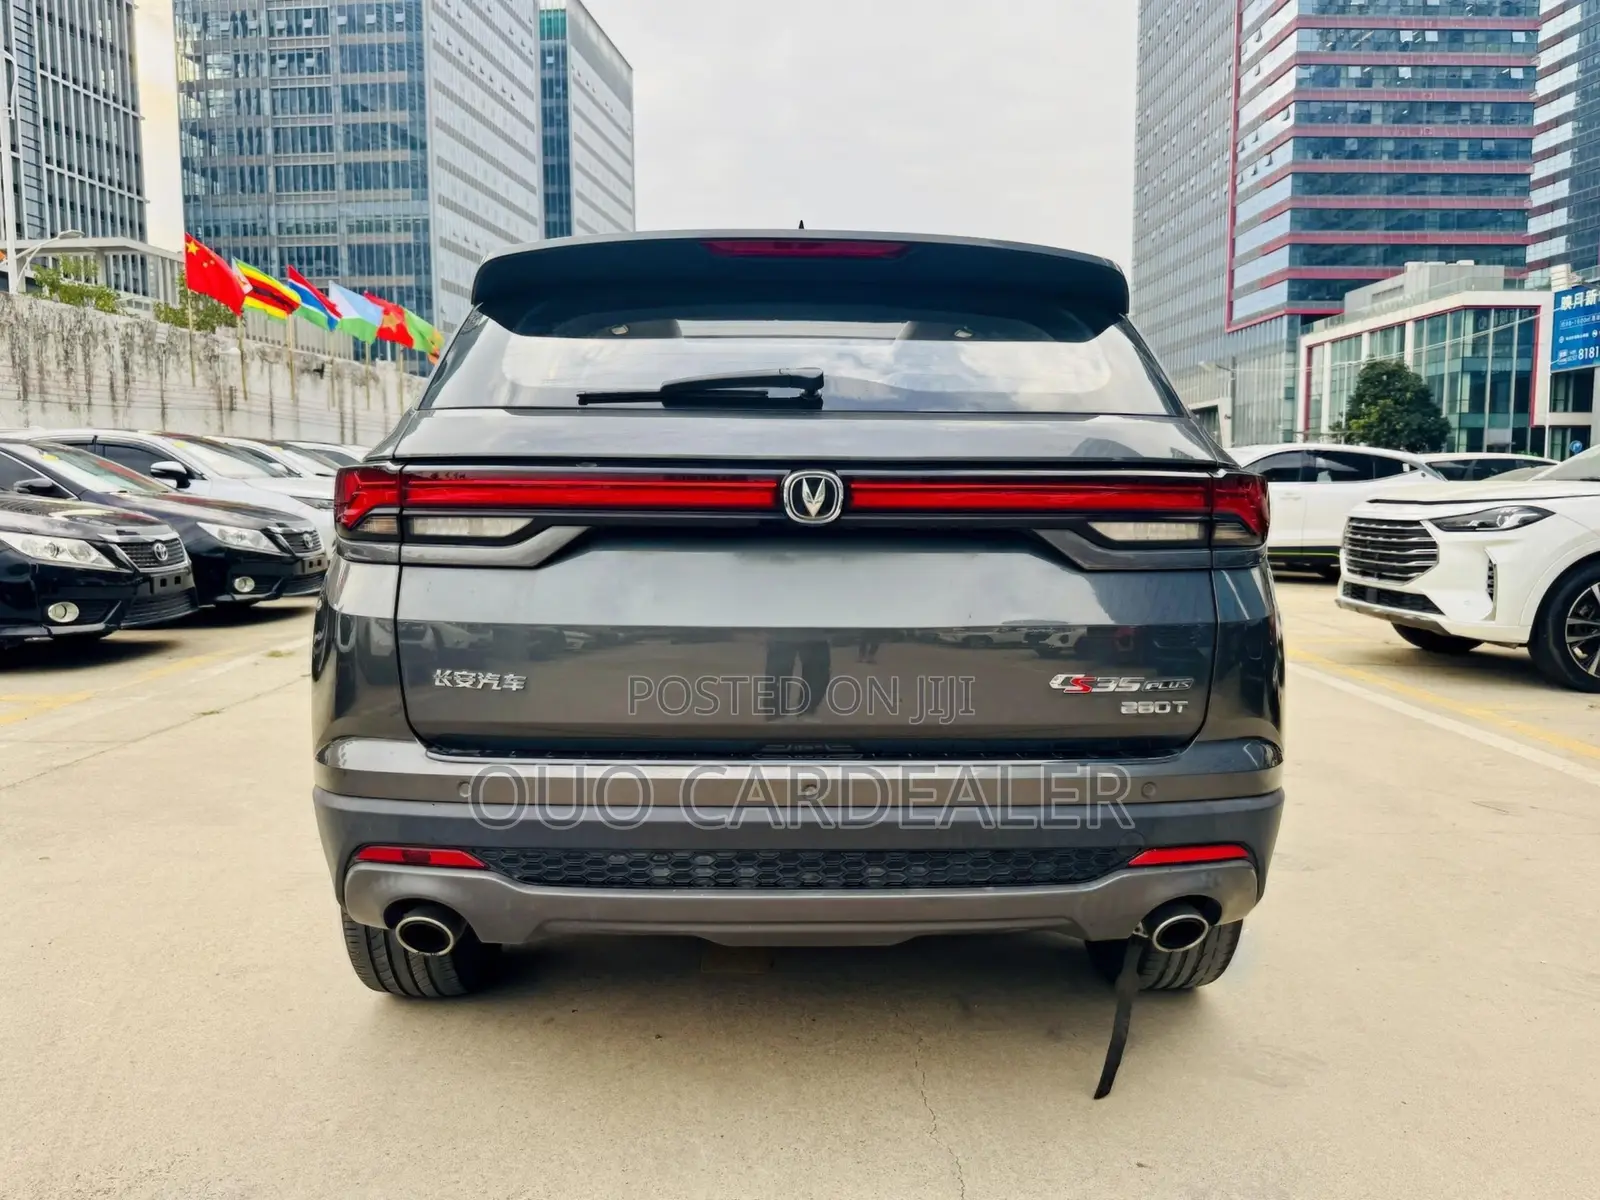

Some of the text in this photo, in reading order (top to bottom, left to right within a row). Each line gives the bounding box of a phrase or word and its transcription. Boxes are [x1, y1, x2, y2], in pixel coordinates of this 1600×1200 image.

[1561, 289, 1600, 311] 映月新
[1578, 346, 1600, 361] 8181
[433, 669, 527, 691] 长安汽车
[1049, 673, 1191, 694] CS35 PLUS
[1120, 701, 1189, 714] 280T
